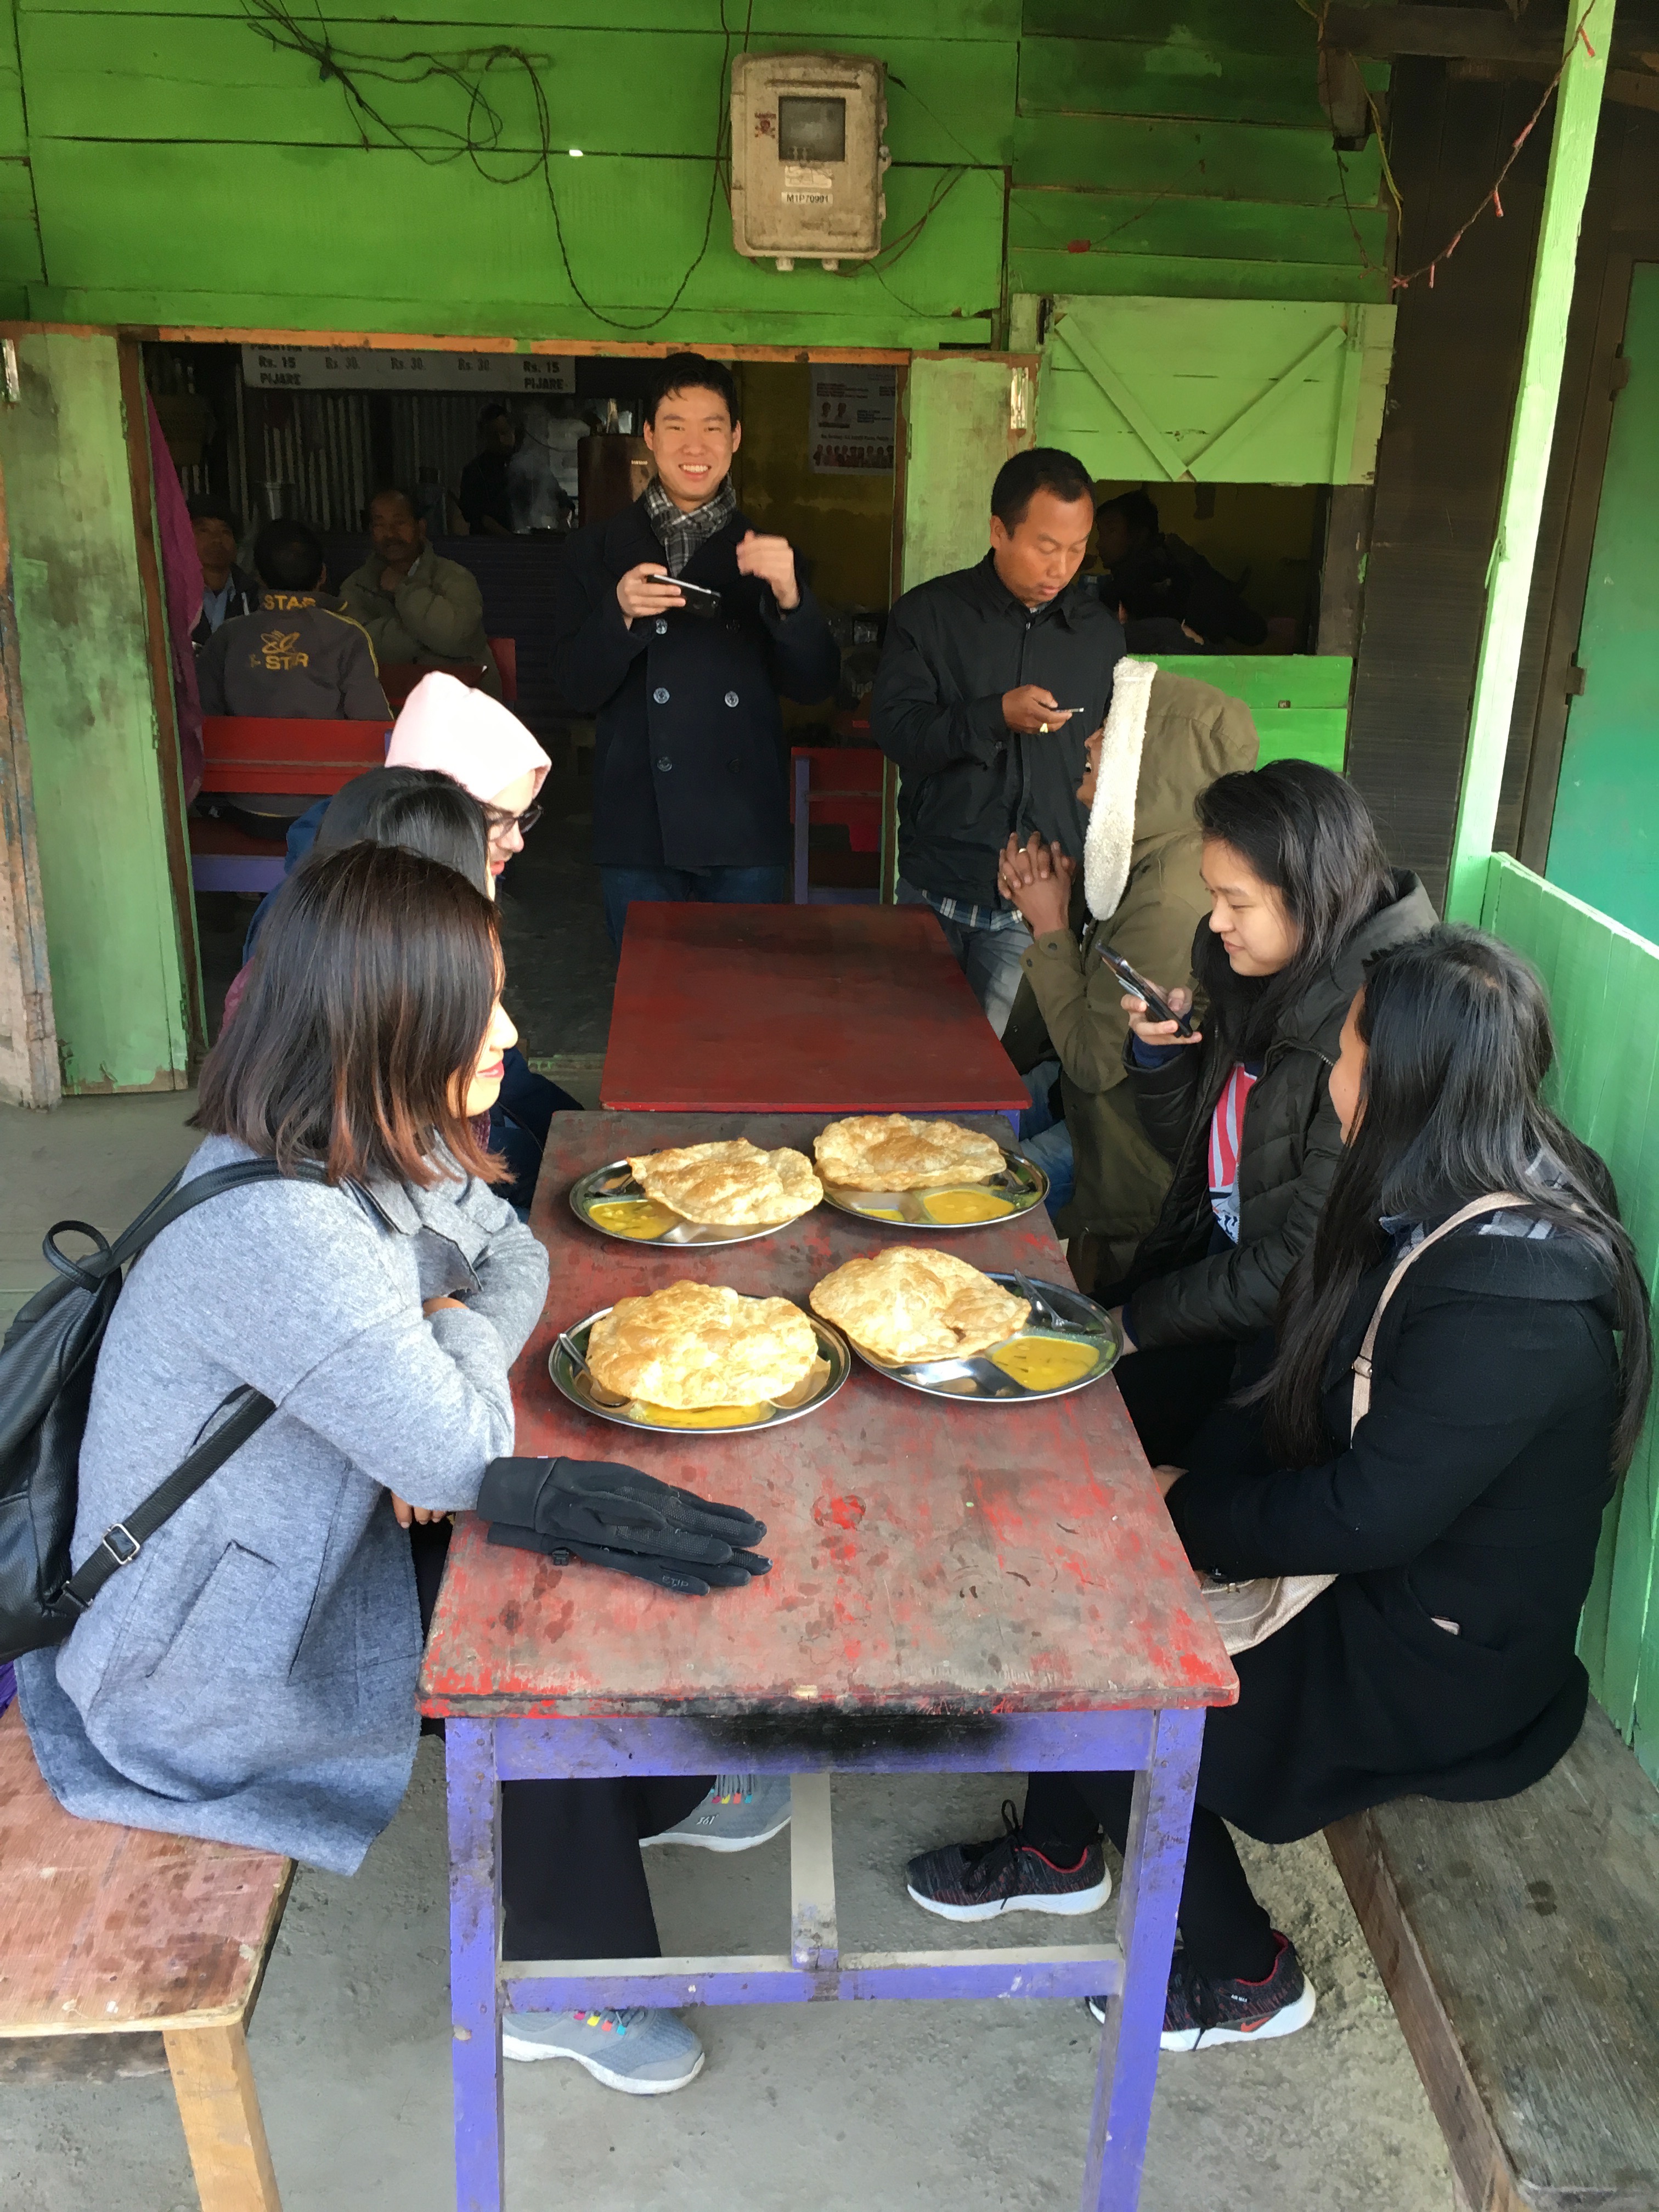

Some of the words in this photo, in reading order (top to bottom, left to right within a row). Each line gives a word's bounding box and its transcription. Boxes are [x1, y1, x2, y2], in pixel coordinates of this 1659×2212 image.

[281, 356, 297, 369] 15
[523, 360, 541, 373] Rs.
[546, 359, 560, 373] 15
